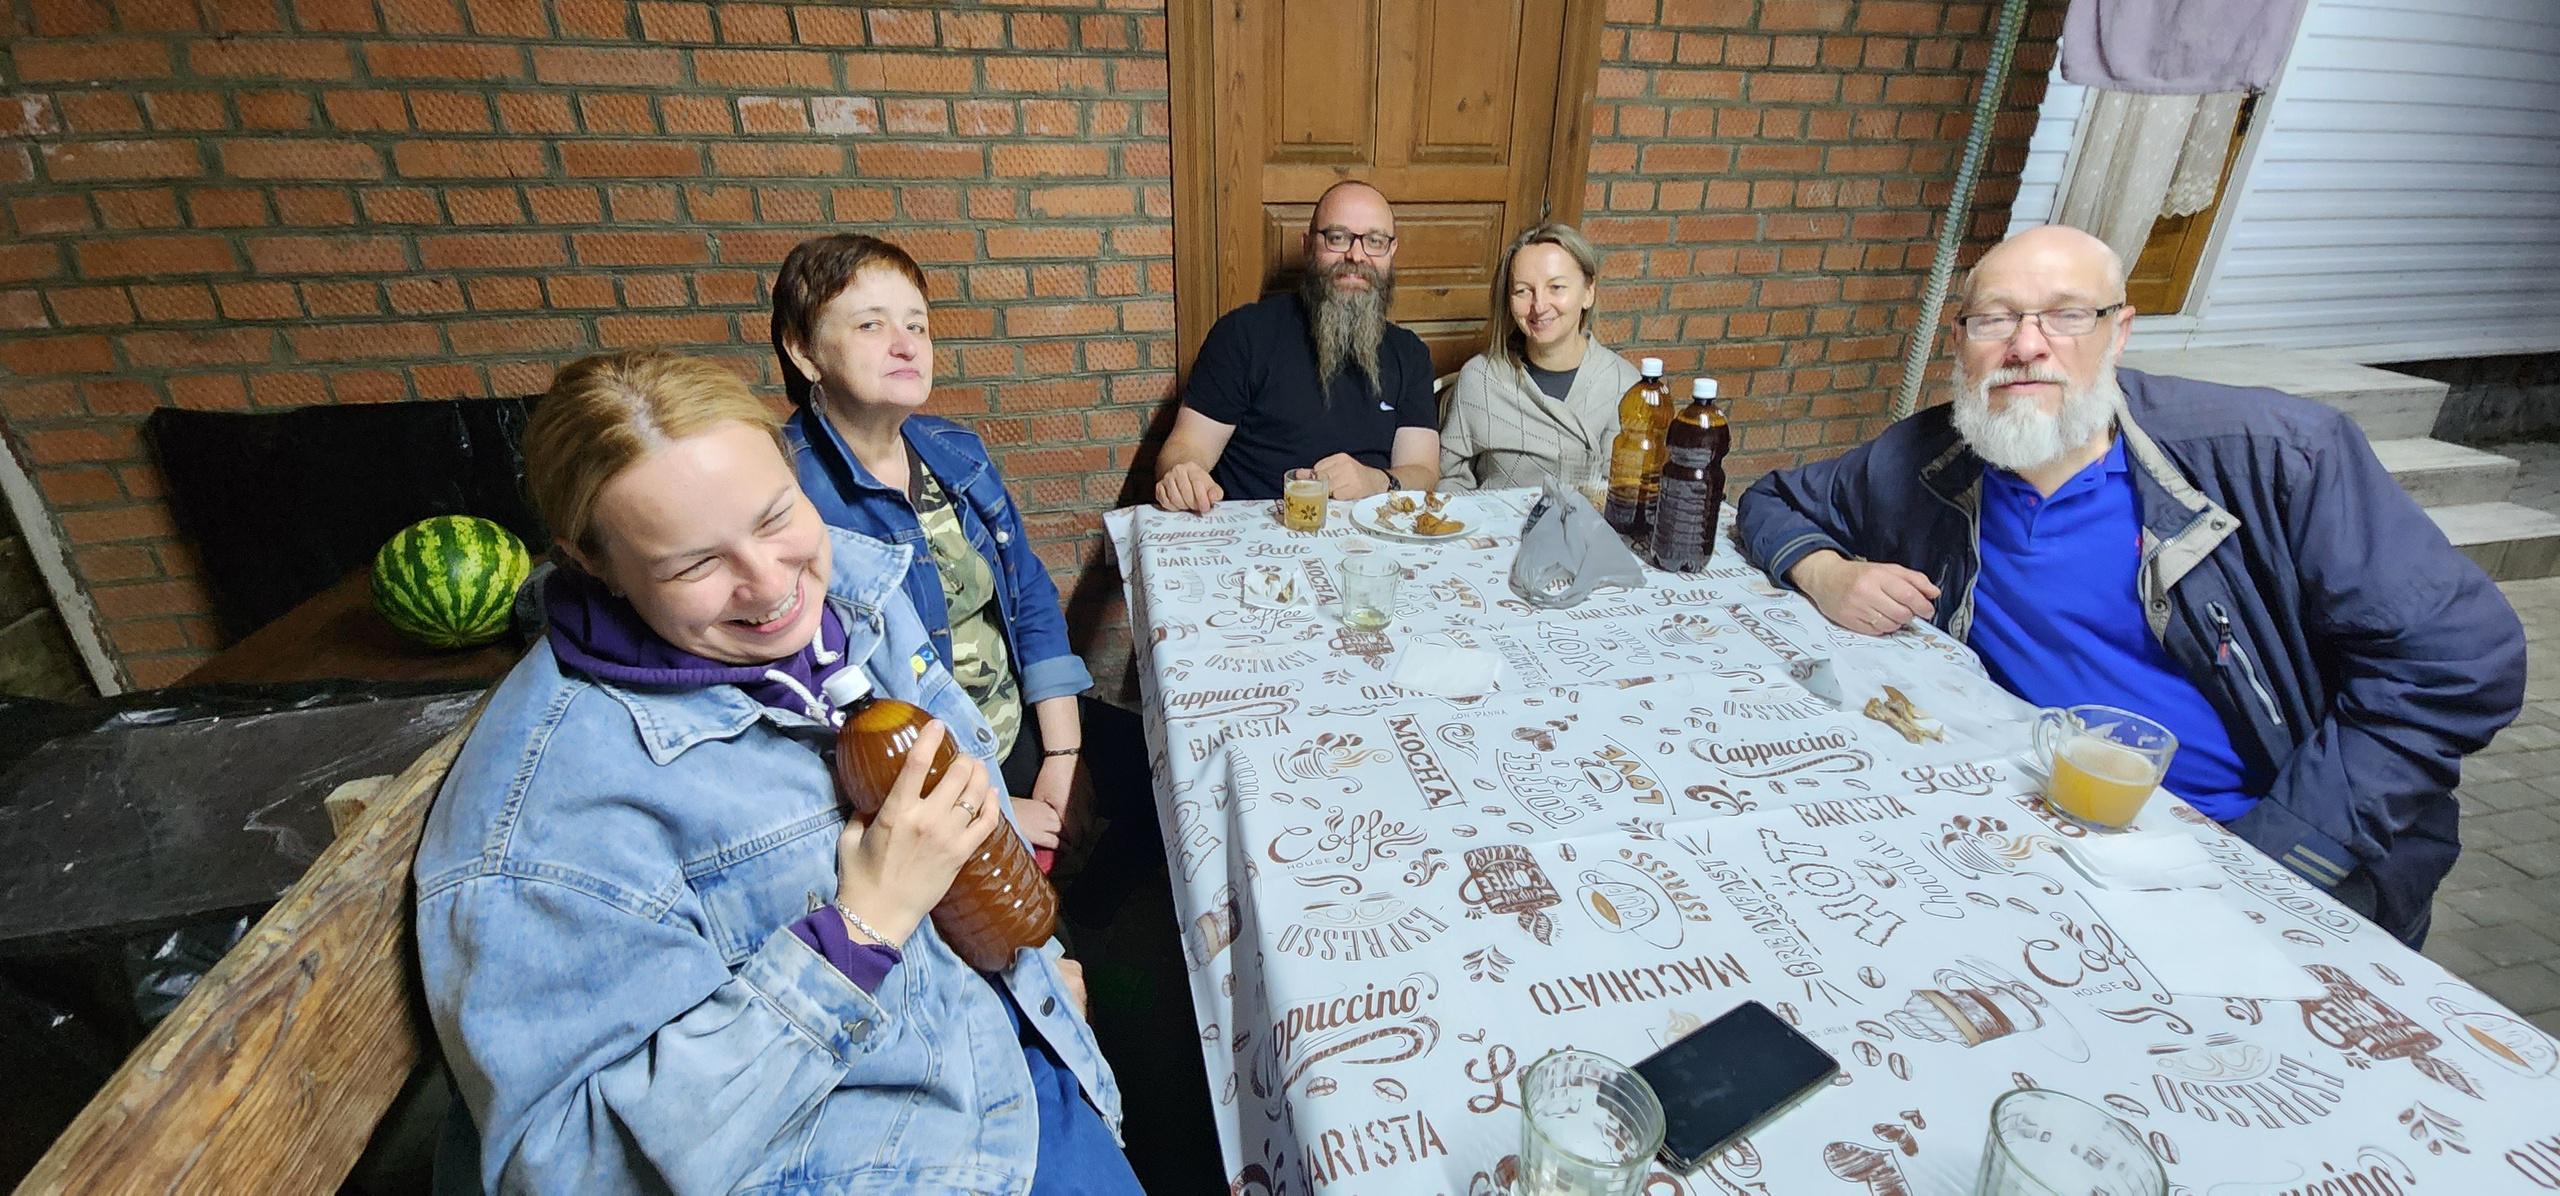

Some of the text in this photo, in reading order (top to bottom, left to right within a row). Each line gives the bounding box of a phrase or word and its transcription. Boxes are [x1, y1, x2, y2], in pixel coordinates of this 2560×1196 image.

[1141, 527, 1237, 543] Cappuccino
[1157, 555, 1232, 568] BARISTA
[1303, 558, 1336, 606] MOCHA
[1651, 588, 1723, 607] Latte
[1566, 604, 1650, 621] BARISTA
[1204, 650, 1319, 675] ESPRESSO
[1537, 621, 1615, 678] HOT
[1162, 682, 1293, 711] Cappuccino
[1188, 716, 1292, 763] BARISTA
[1709, 731, 1847, 769] Cappuccino
[1388, 717, 1454, 806] MOCHA
[1593, 744, 1664, 805] LOVE
[1901, 762, 2006, 796] Latte
[1502, 751, 1585, 825] COFFEE
[1791, 794, 1917, 828] BARISTA
[1267, 809, 1427, 872] Coffee
[1286, 857, 1333, 871] HOUSE
[1477, 865, 1547, 894] COFFEE
[1602, 885, 1655, 921] CUP
[1756, 827, 1966, 948] HOT Chocolate
[1276, 906, 1451, 961] ESPRESSO
[1694, 858, 1825, 979] BREAKFAST
[1528, 952, 1752, 1016] MACCHIATO
[2072, 980, 2122, 998] HOUSE
[2151, 1053, 2346, 1130] ESPRESSO
